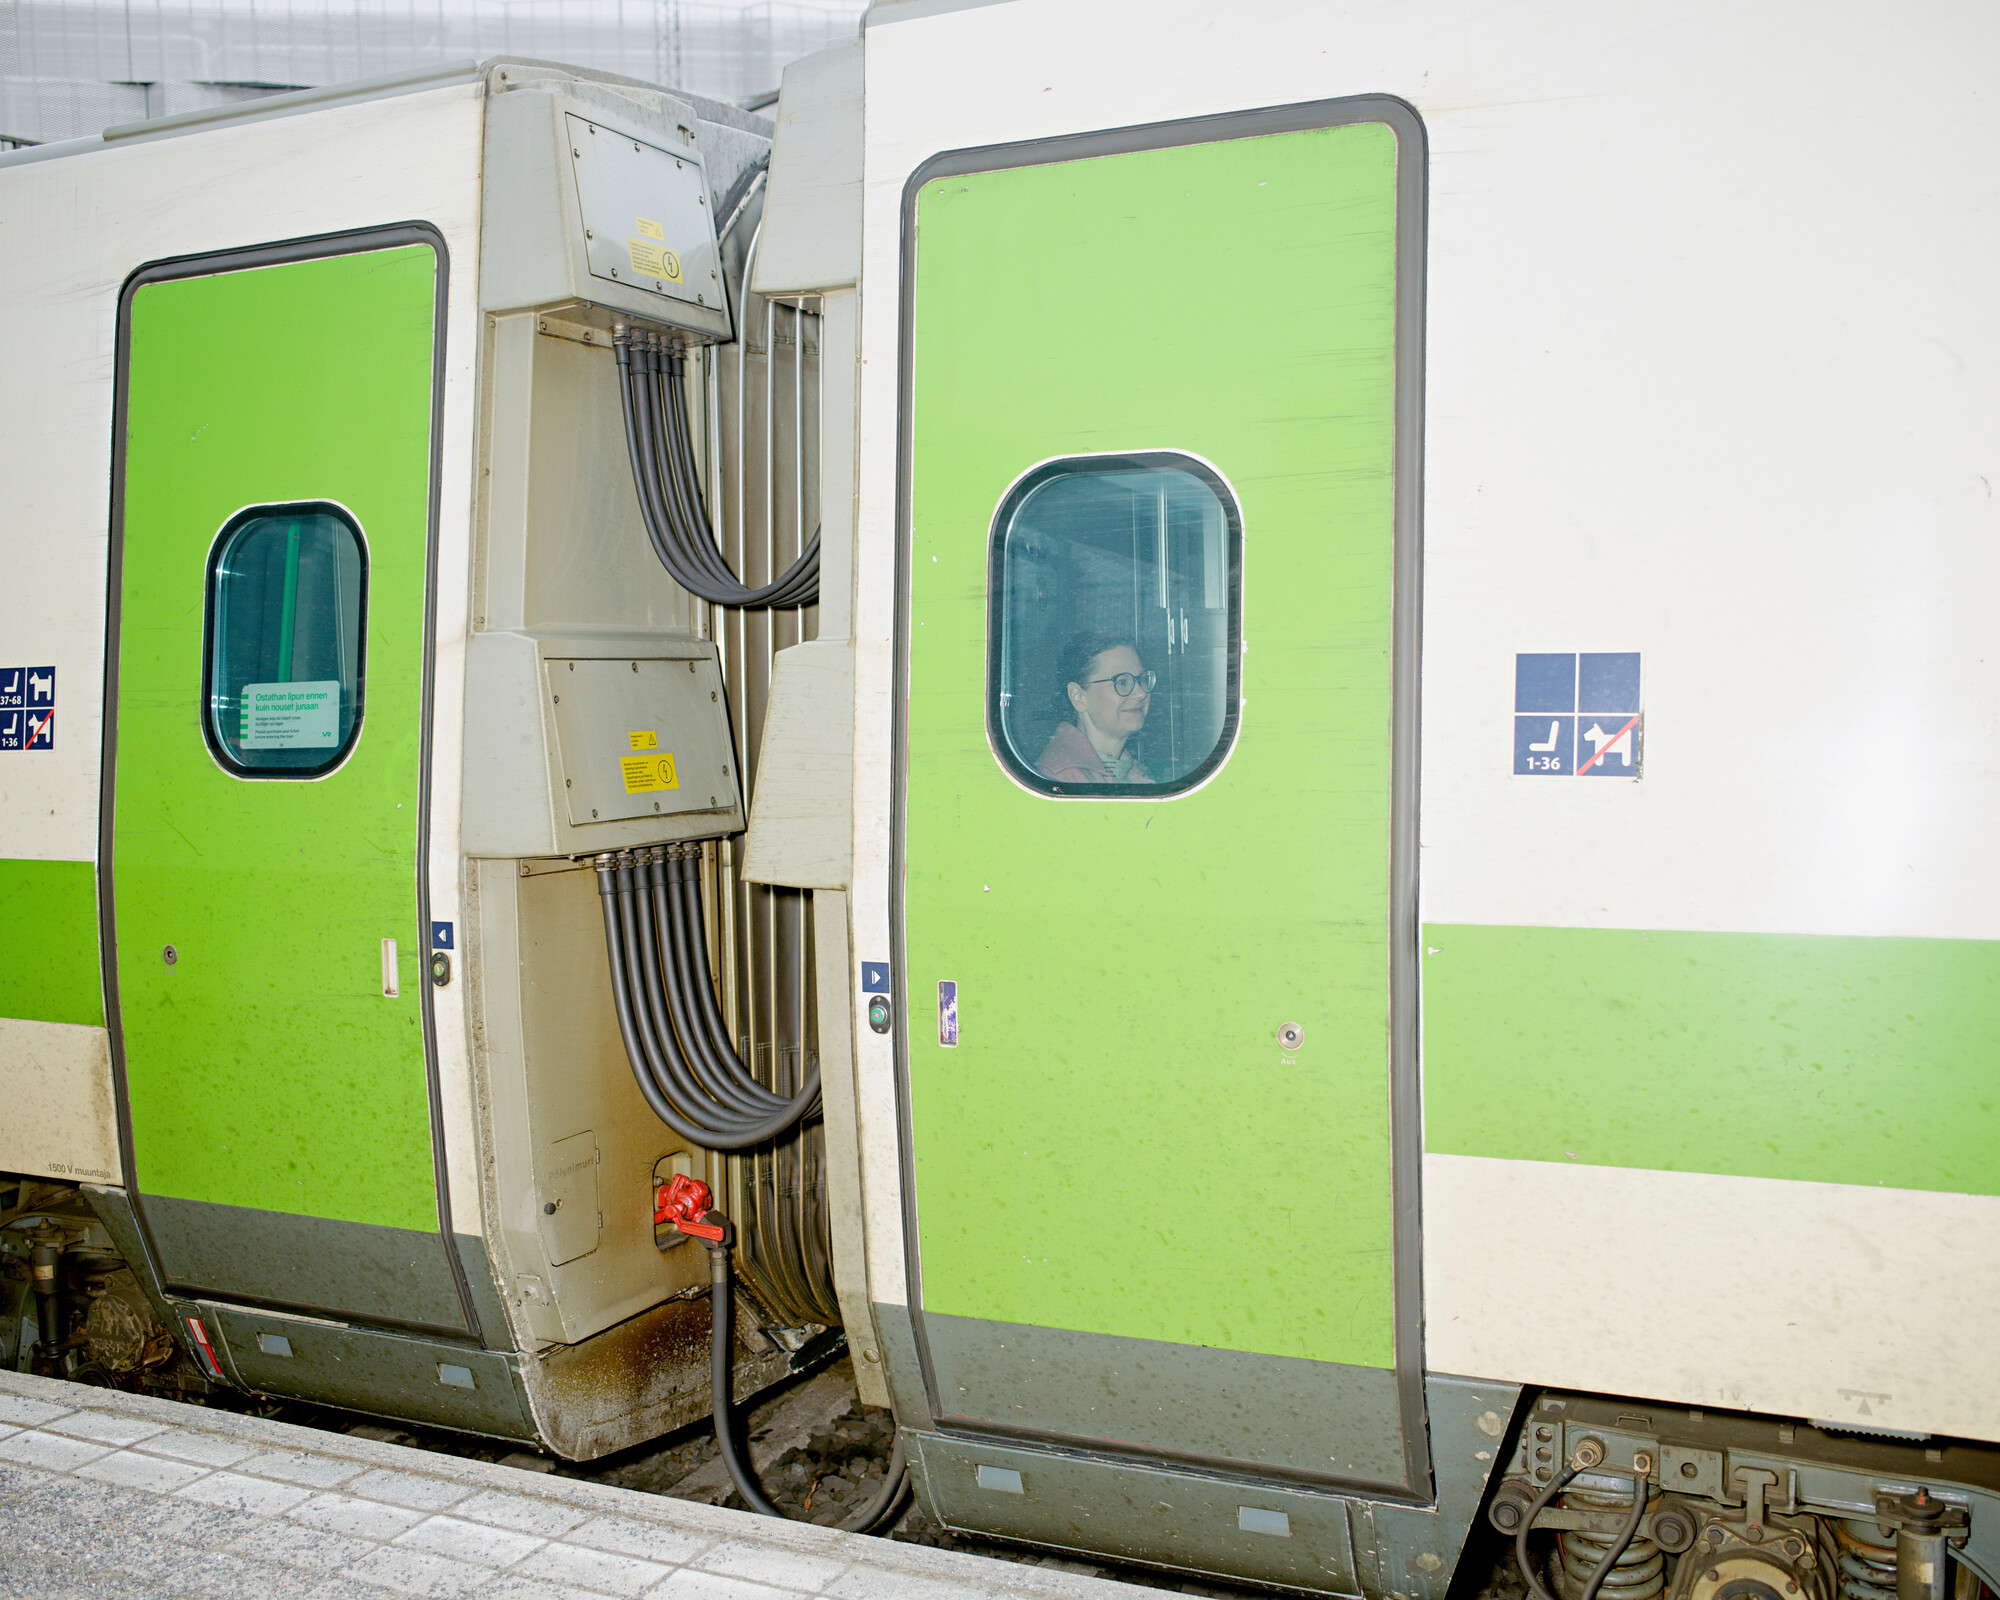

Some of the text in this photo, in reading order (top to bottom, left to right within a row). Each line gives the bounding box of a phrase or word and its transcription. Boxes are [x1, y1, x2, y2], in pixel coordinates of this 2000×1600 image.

[0, 695, 22, 706] 37-68
[255, 692, 328, 702] Ostathan lipun ennen
[255, 703, 319, 712] kuin nouset junaan
[2, 737, 18, 747] 1-36
[1526, 756, 1561, 770] 1-36
[48, 1162, 111, 1180] 1500 V muuntaja
